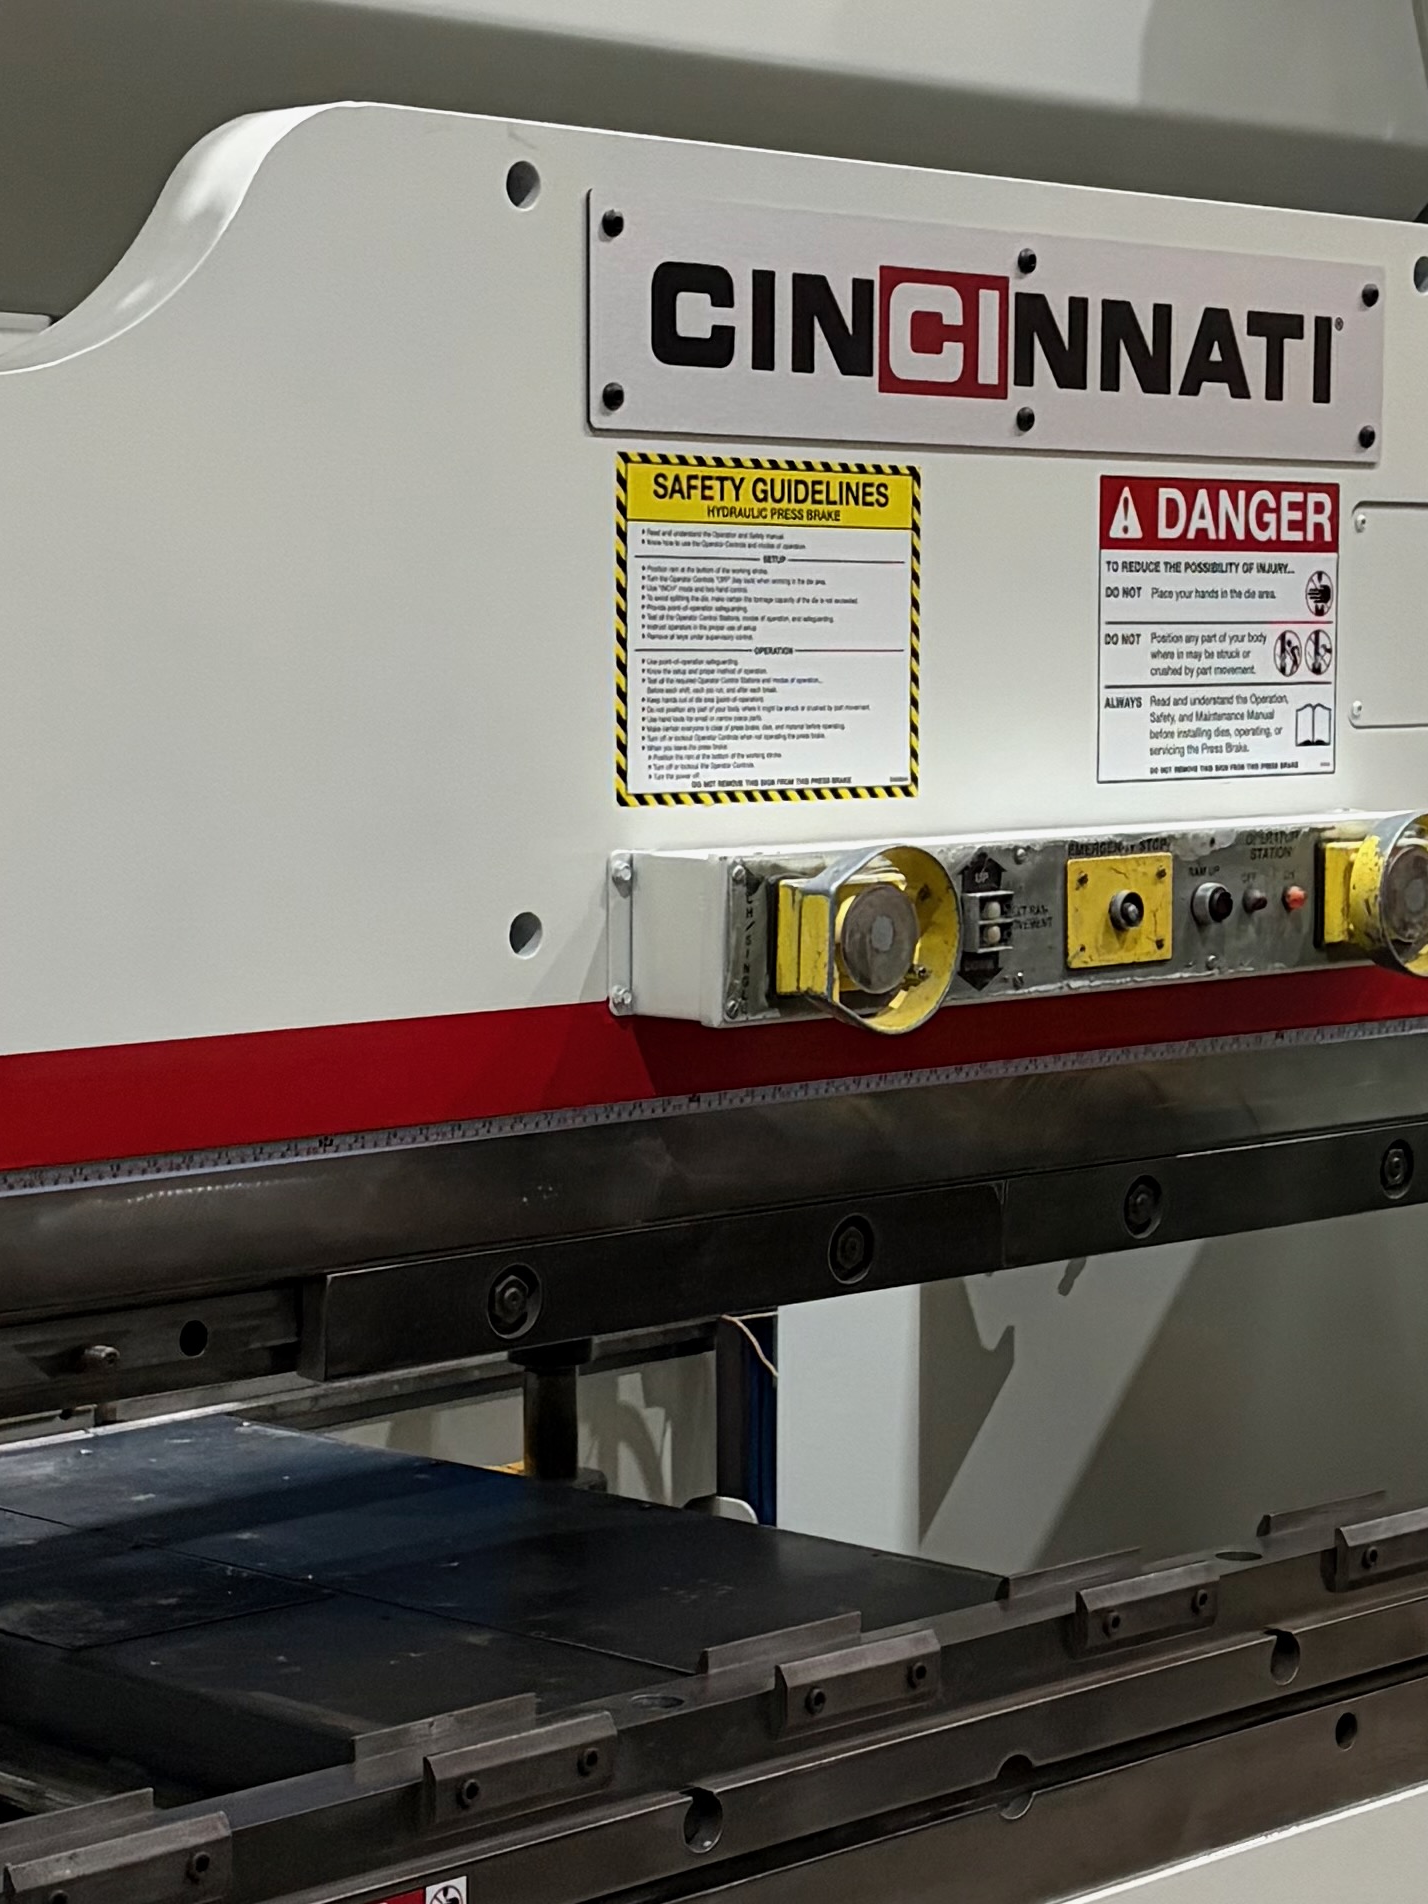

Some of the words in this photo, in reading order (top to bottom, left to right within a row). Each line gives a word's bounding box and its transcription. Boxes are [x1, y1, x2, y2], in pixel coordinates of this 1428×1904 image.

[650, 260, 1333, 405] CINCINNATI
[653, 473, 745, 502] SAFETY
[751, 479, 890, 508] GUIDELINES
[707, 506, 767, 519] HYDRAULIC
[771, 508, 804, 521] PRESS
[806, 509, 841, 522] BRAKE
[1157, 487, 1332, 542] DANGER
[1106, 561, 1118, 573] TO
[1122, 561, 1160, 573] REDUCE
[1164, 562, 1182, 573] THE
[1184, 562, 1239, 574] POSSIBILITY
[1242, 562, 1254, 574] OF
[1105, 587, 1119, 598] DO
[1122, 587, 1142, 598] NOT
[1151, 587, 1173, 599] Place
[1175, 589, 1194, 601] your
[1195, 588, 1219, 599] hands
[1230, 588, 1242, 599] the
[1104, 634, 1118, 645] DO
[1122, 634, 1141, 645] NOT
[1151, 633, 1183, 644] Position
[1185, 634, 1199, 645] any
[1201, 634, 1217, 645] part
[1228, 634, 1246, 645] your
[1248, 633, 1267, 645] body
[1151, 649, 1174, 660] where
[1204, 649, 1214, 659] be
[1150, 665, 1182, 676] crushed
[1185, 666, 1194, 678] by
[1196, 666, 1212, 677] part
[1104, 697, 1142, 708] ALWAYS
[1150, 696, 1170, 706] Read
[1173, 696, 1188, 706] and
[1190, 696, 1234, 706] understand
[1236, 695, 1247, 705] the
[1150, 711, 1175, 725] Safety,
[1178, 711, 1193, 722] and
[1247, 710, 1275, 720] Manual
[1150, 729, 1175, 739] before
[1187, 744, 1199, 754] the
[1201, 744, 1223, 754] Press
[1068, 841, 1134, 856] EMERGENY
[1250, 847, 1292, 860] STATION
